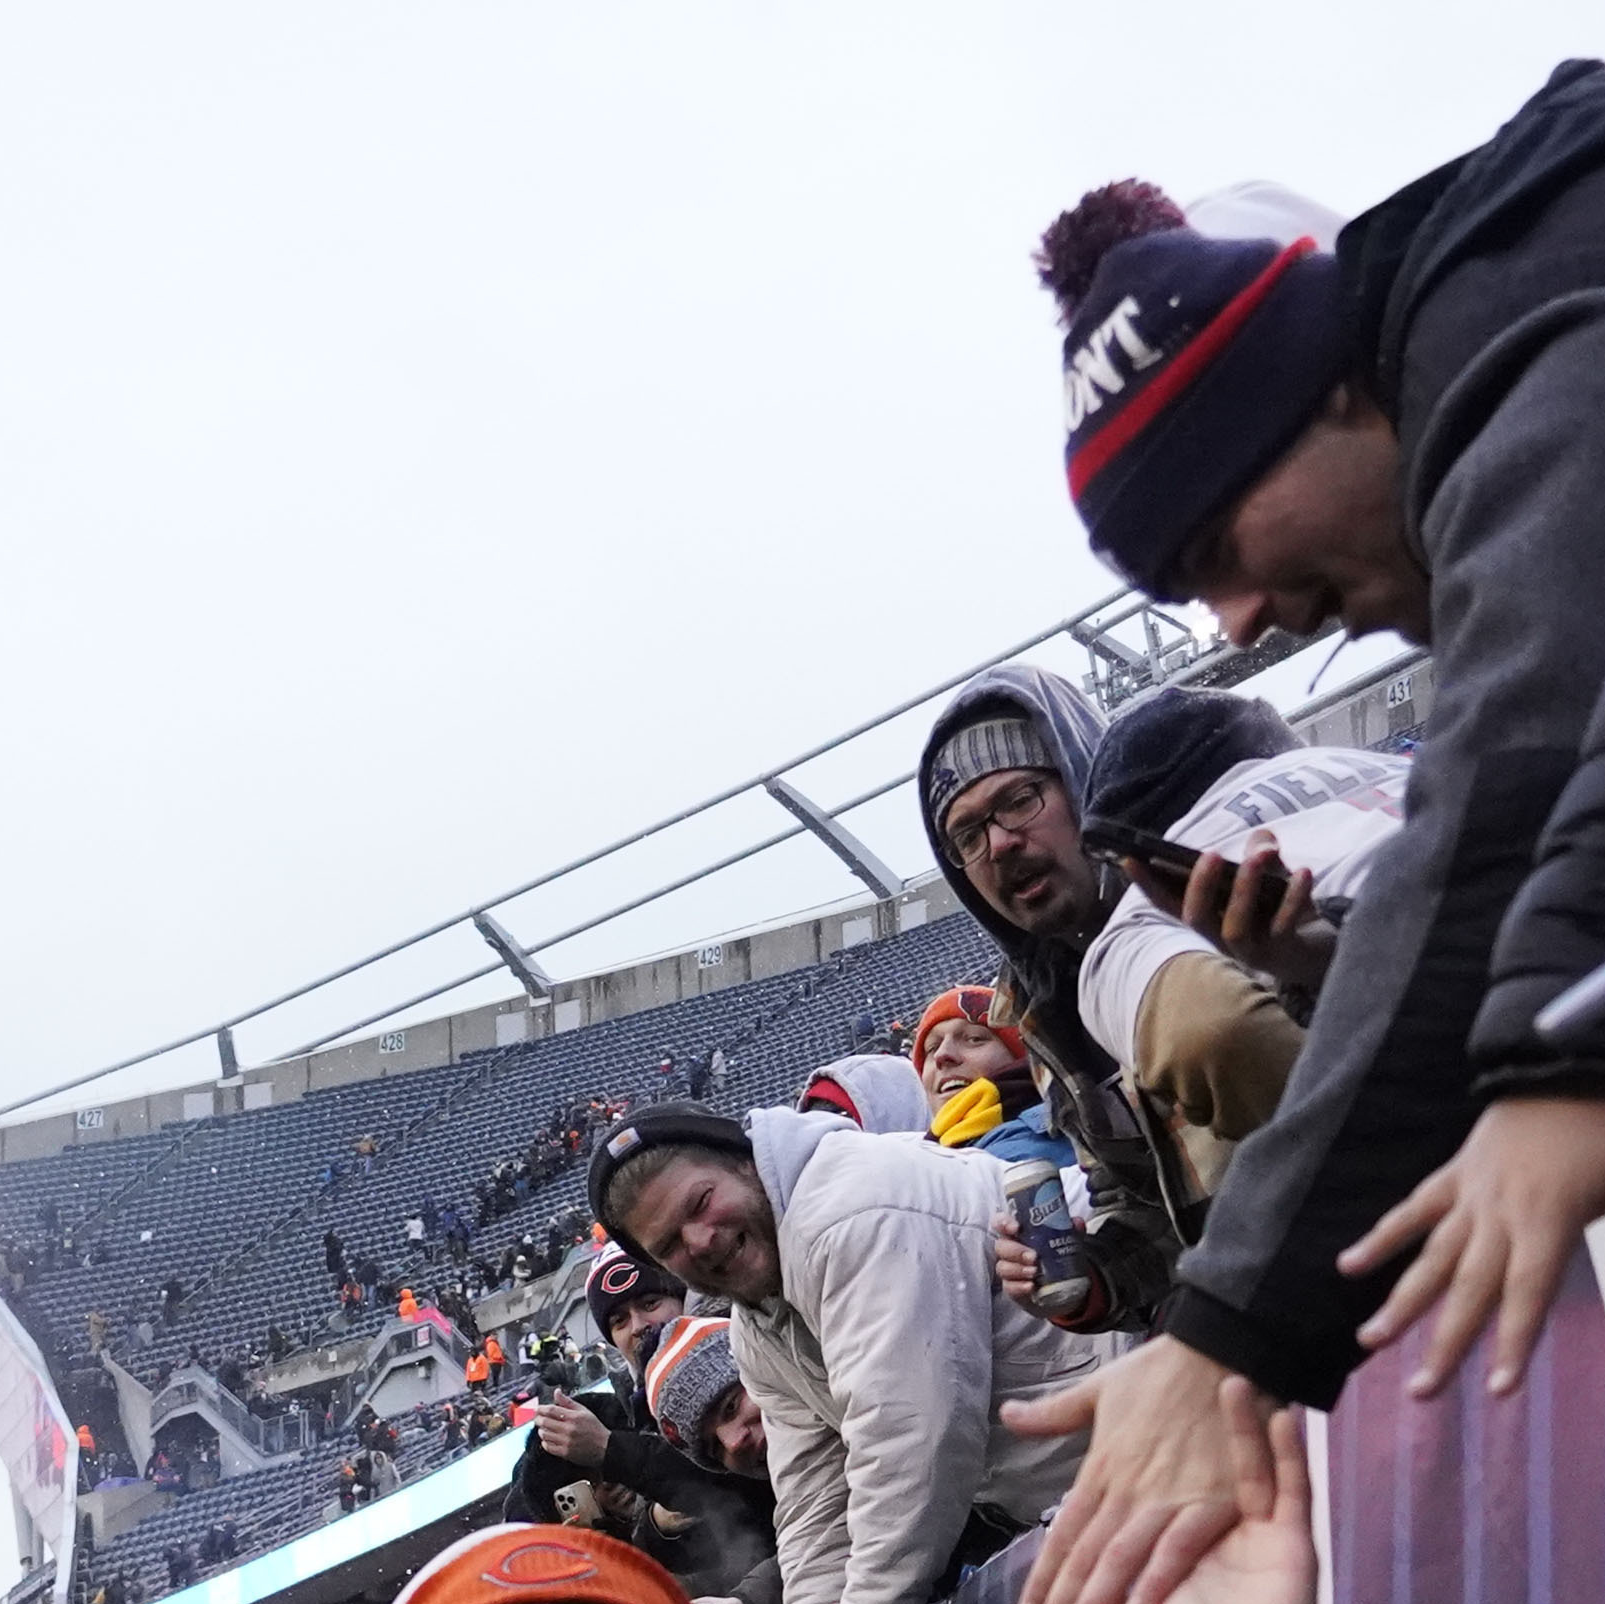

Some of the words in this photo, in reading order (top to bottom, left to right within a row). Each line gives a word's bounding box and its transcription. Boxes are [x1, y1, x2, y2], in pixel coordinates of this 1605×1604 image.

[1390, 678, 1411, 704] 431
[700, 946, 721, 964] 429
[79, 1111, 102, 1128] 427
